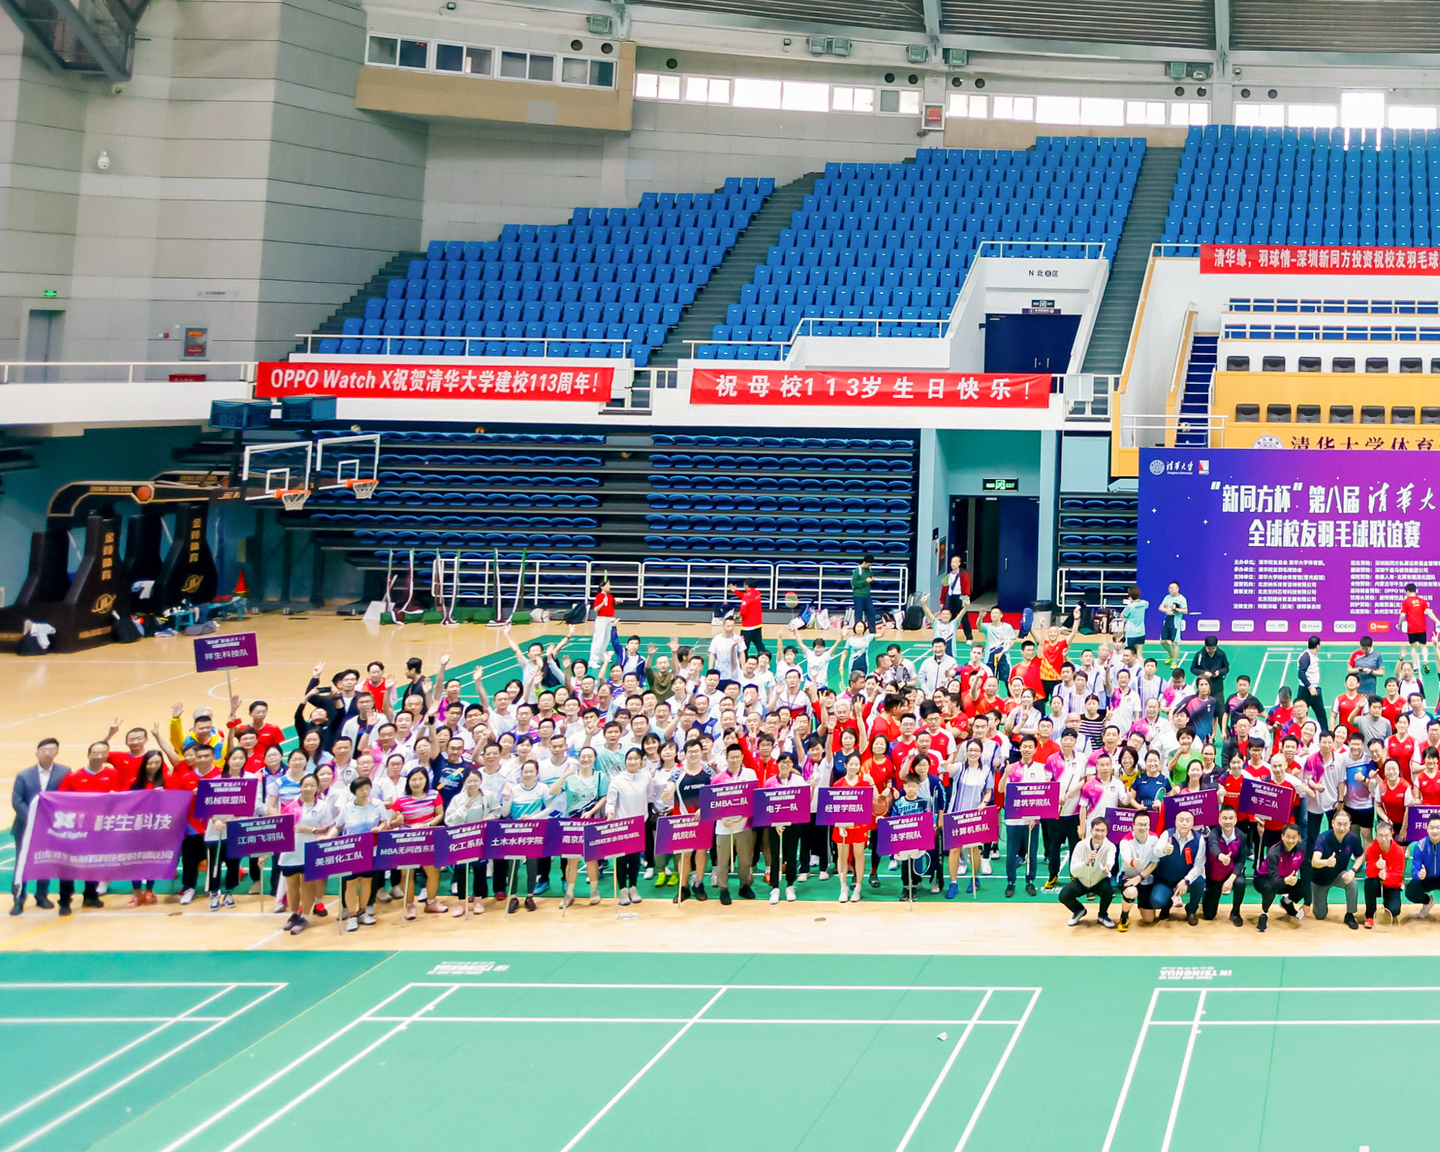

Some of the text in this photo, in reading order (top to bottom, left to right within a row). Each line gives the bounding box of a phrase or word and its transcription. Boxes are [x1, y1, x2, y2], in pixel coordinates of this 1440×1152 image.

[270, 369, 319, 389] OPPO
[322, 370, 376, 390] Watch
[1248, 518, 1421, 548] 全球校友羽毛球联谊赛
[204, 649, 249, 660] 祥生科技队
[204, 796, 247, 805] 机械联盟队
[710, 797, 749, 810] EMBA二队
[1013, 798, 1052, 808] 建筑学院队
[1250, 796, 1279, 810] 电子二队
[766, 802, 798, 814] 电子一队
[824, 803, 864, 813] 经管学院队
[672, 831, 698, 842] 航院队
[951, 824, 990, 837] 计算机系队
[237, 833, 286, 845] 江南飞羽队
[490, 836, 544, 847] 土木水利学院
[890, 831, 922, 843] 法学院队
[448, 838, 485, 852] 化工系队
[315, 850, 364, 868] 美丽化工队
